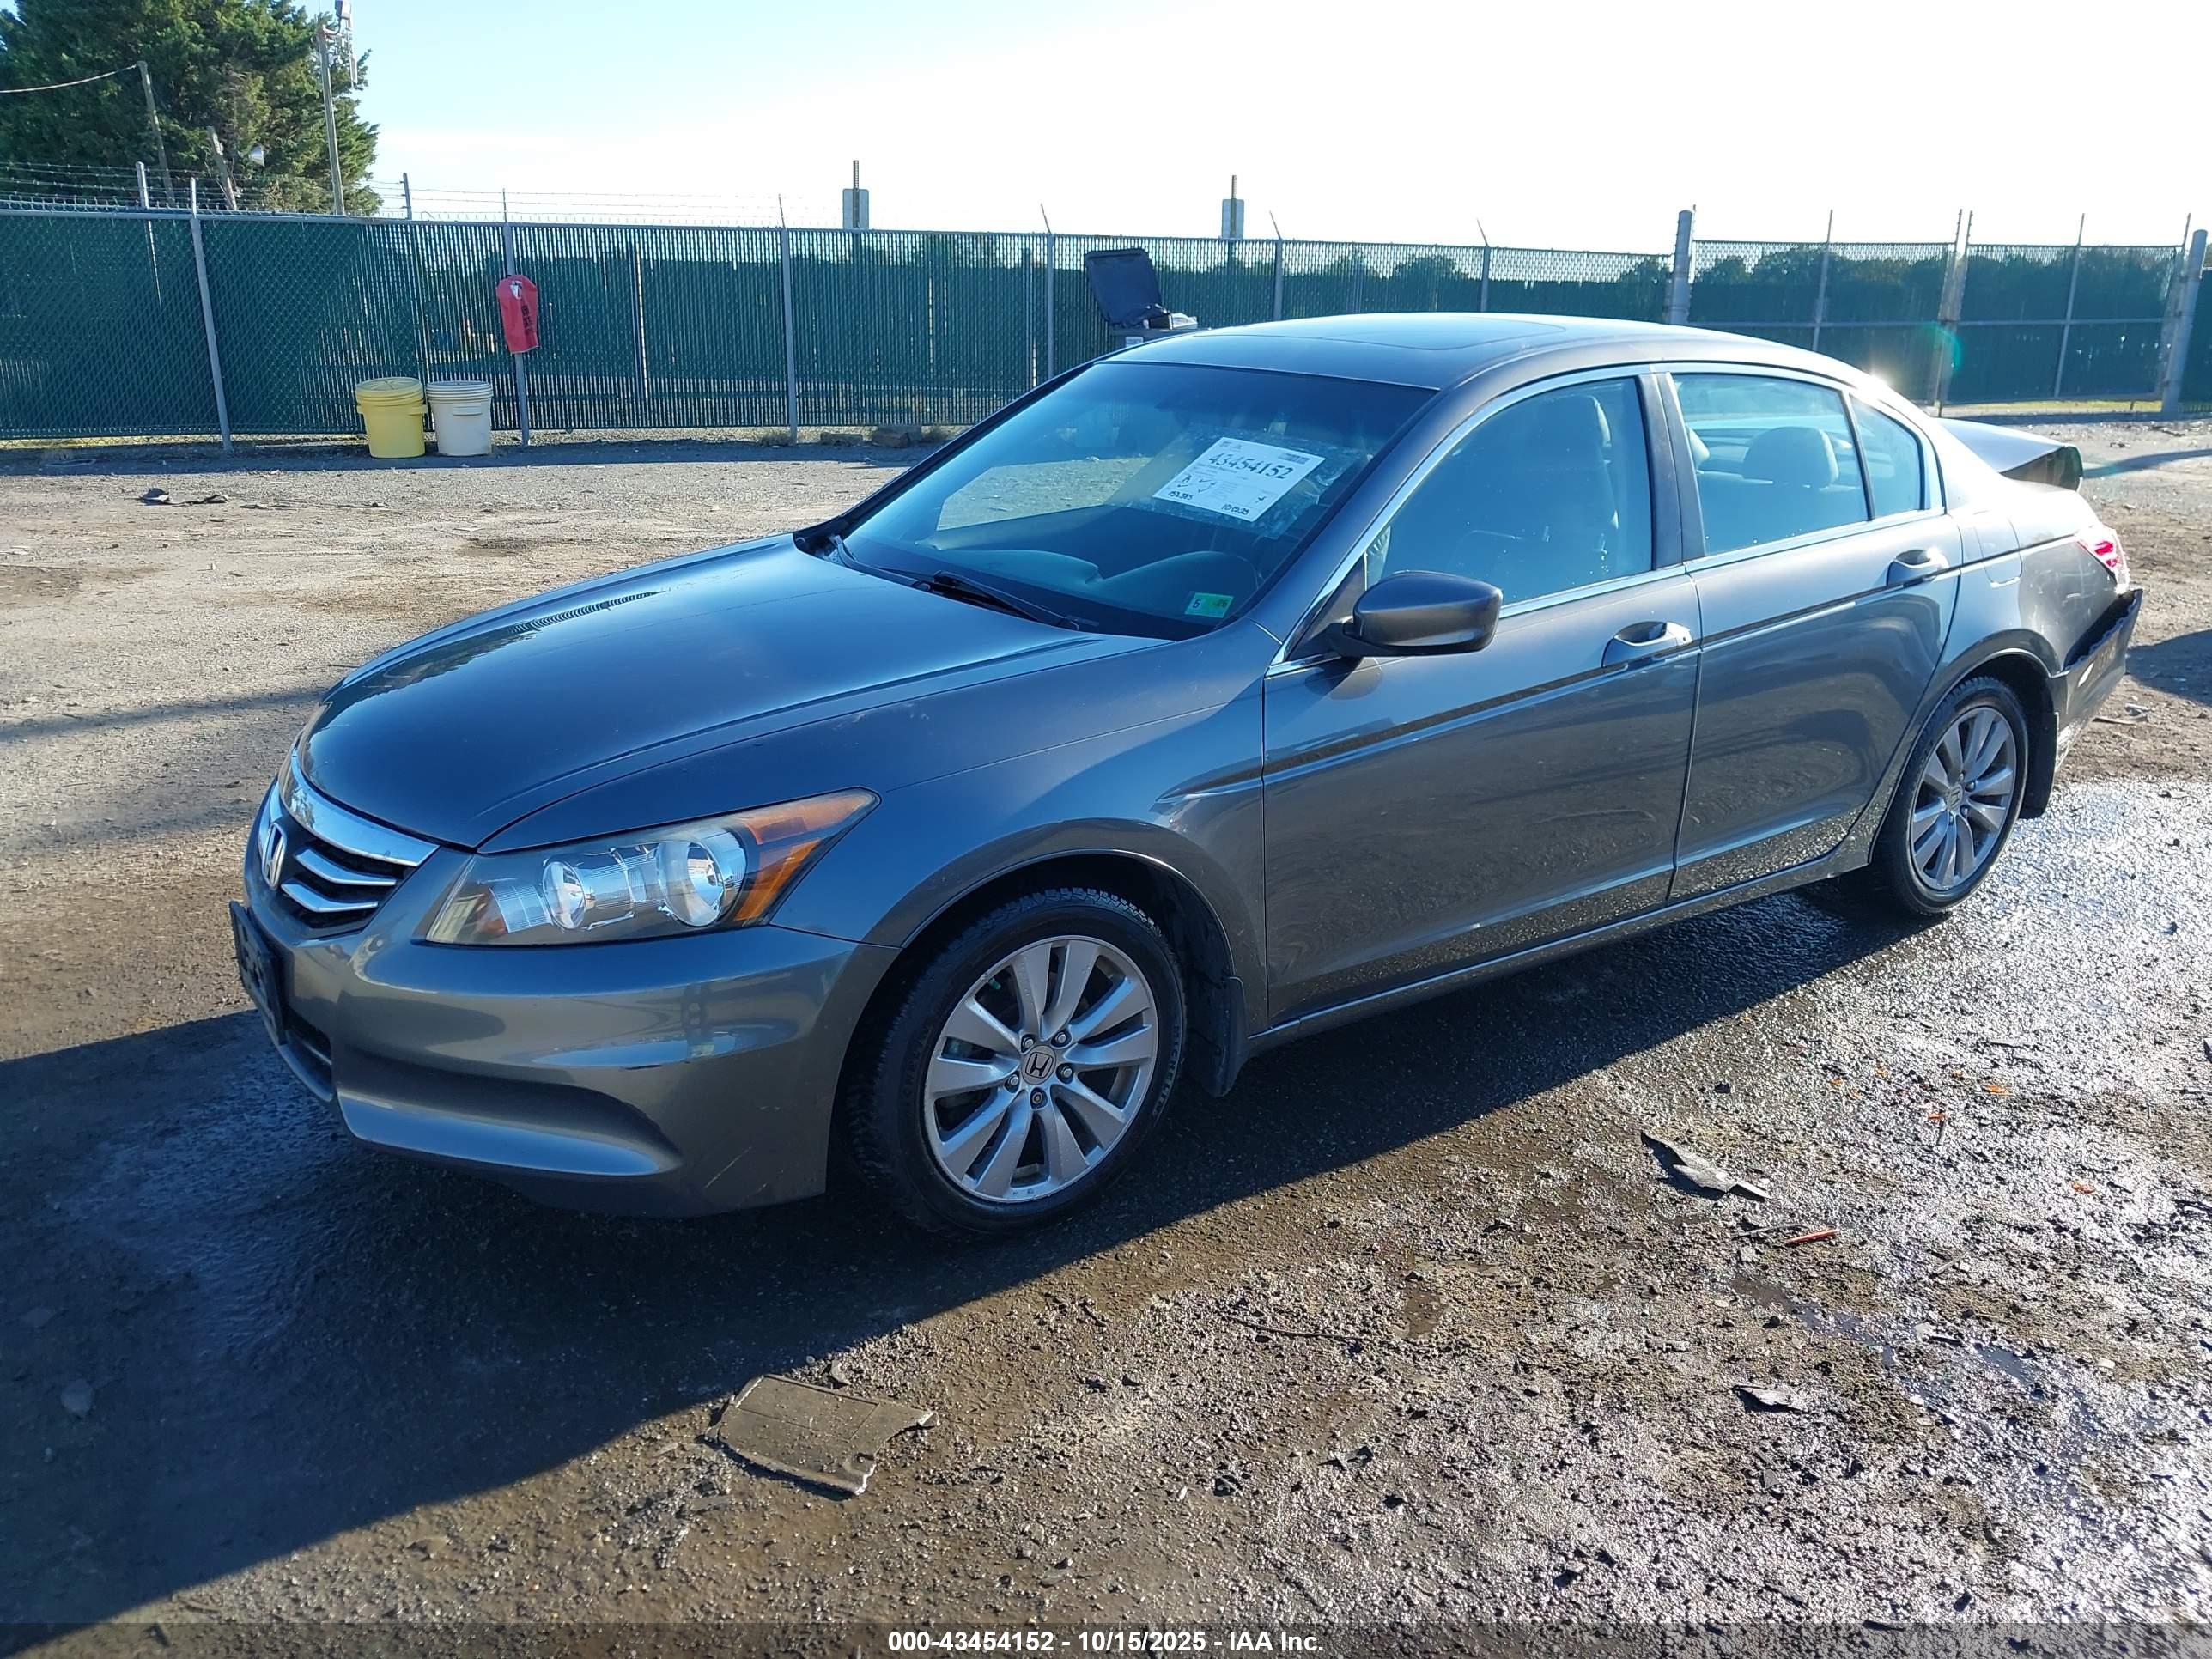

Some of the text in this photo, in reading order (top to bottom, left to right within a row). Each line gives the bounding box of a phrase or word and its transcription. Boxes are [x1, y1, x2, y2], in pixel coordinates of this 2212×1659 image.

[1209, 453, 1293, 479] 43454152
[1193, 599, 1201, 608] 5
[1153, 1024, 1180, 1113] MICHELIN
